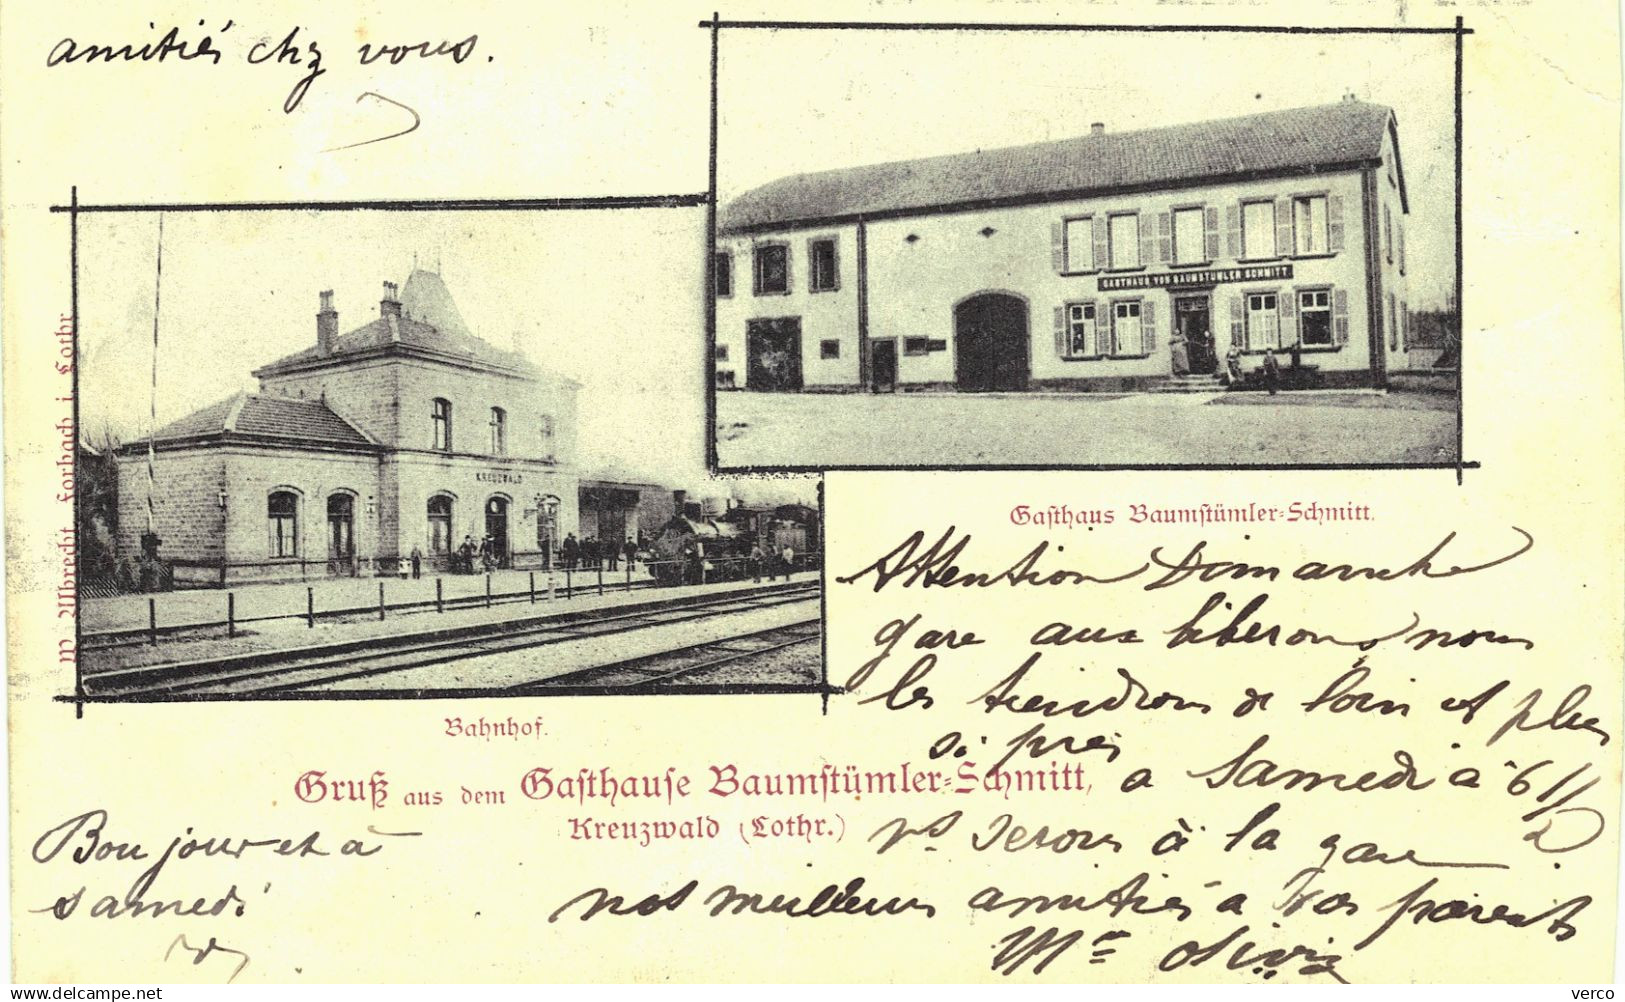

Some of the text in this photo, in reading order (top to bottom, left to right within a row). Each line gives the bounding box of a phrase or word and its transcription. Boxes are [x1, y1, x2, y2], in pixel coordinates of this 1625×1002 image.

[1244, 266, 1288, 279] SCHMITT
[443, 716, 549, 742] Bahnhof.
[294, 769, 389, 810] Gruß
[403, 789, 444, 806] aus
[461, 786, 507, 805] dem
[568, 816, 721, 848] Kreuzwald
